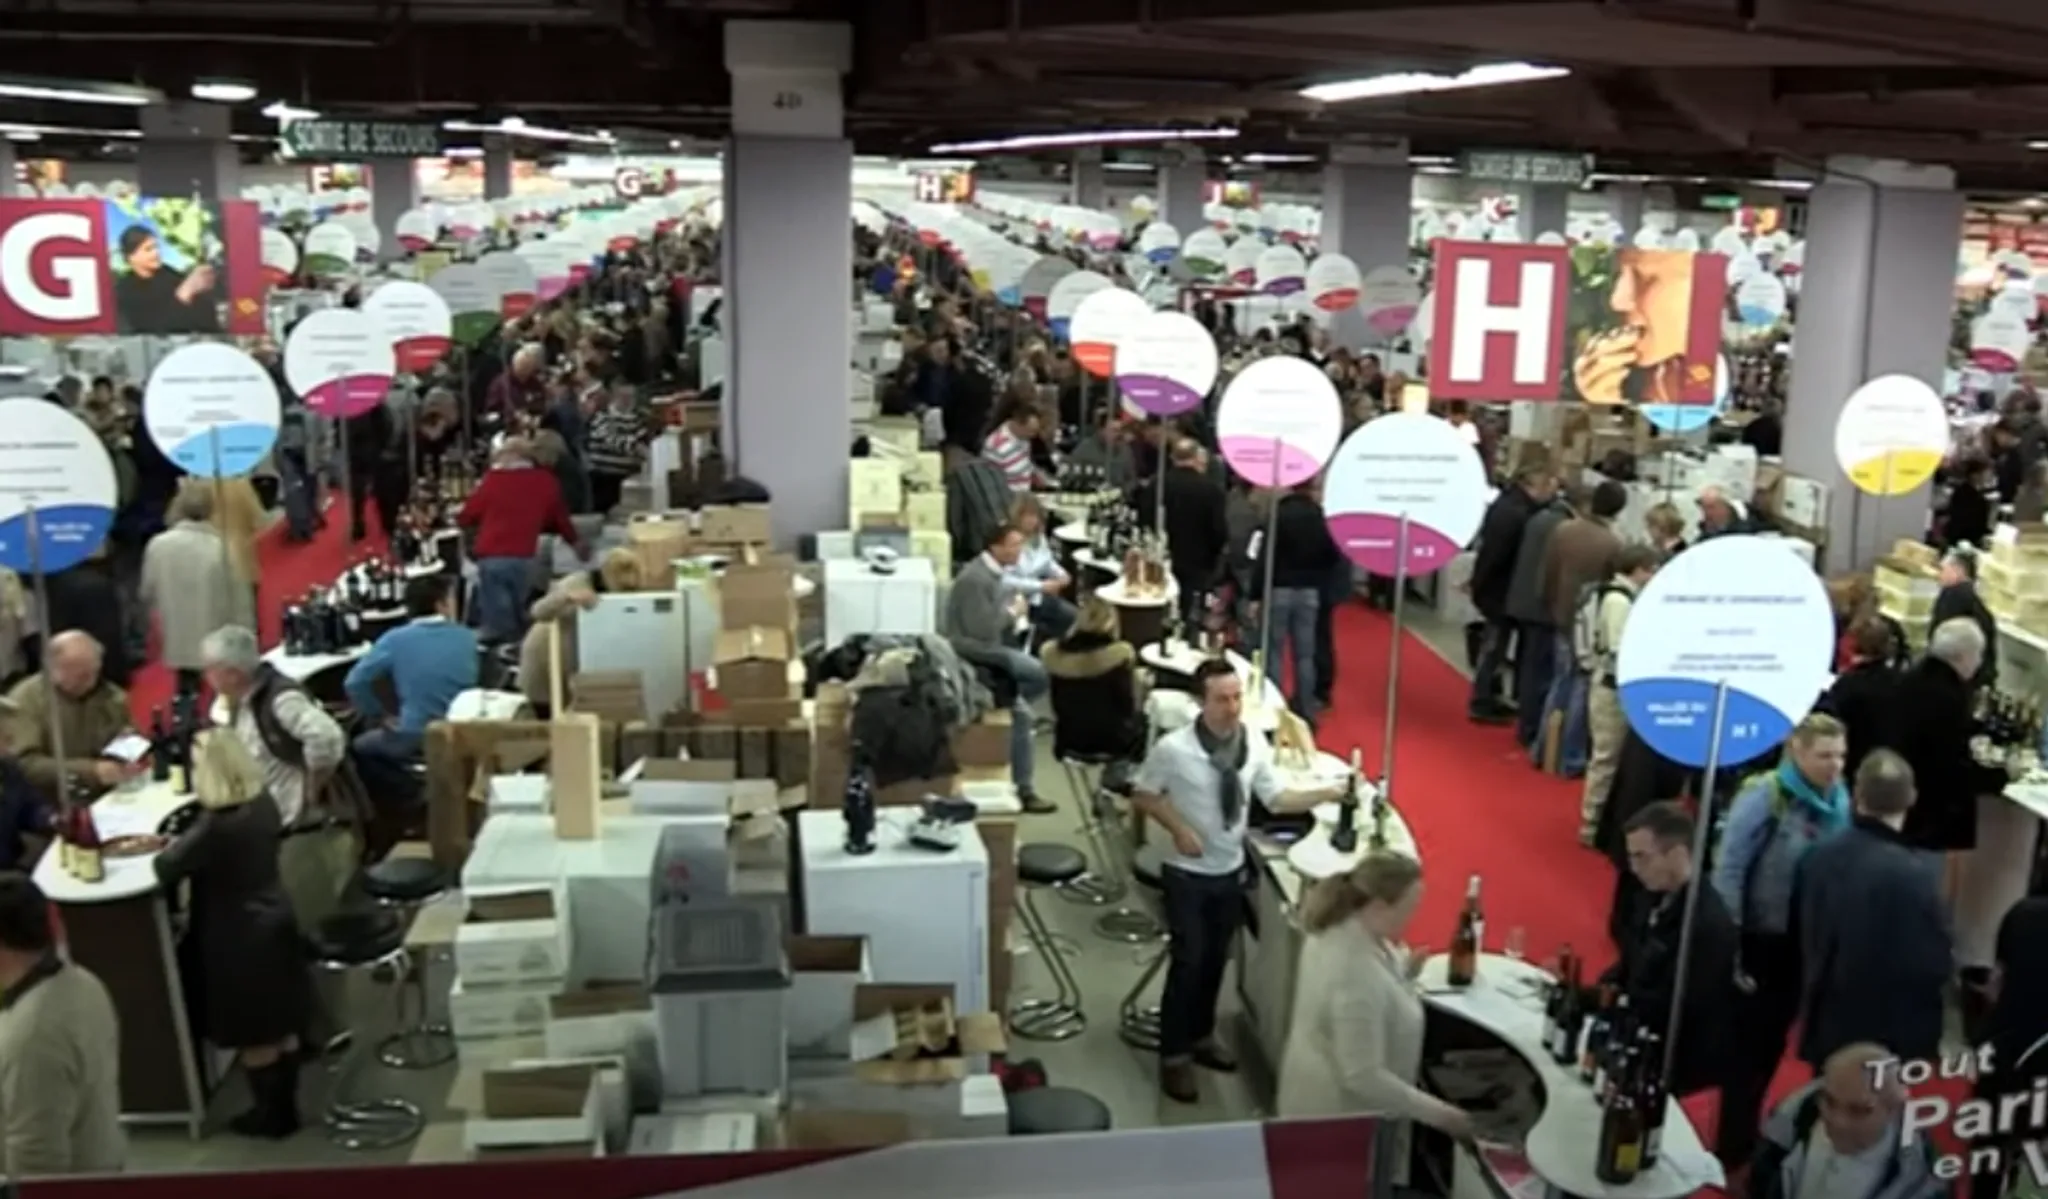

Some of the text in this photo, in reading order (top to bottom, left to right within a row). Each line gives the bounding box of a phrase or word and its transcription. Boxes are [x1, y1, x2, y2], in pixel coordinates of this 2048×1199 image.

[294, 121, 438, 153] SORTIE DE SECOURS
[618, 172, 640, 196] G
[920, 175, 940, 199] H
[1482, 197, 1503, 222] K
[0, 212, 100, 321] G
[1450, 258, 1555, 393] H
